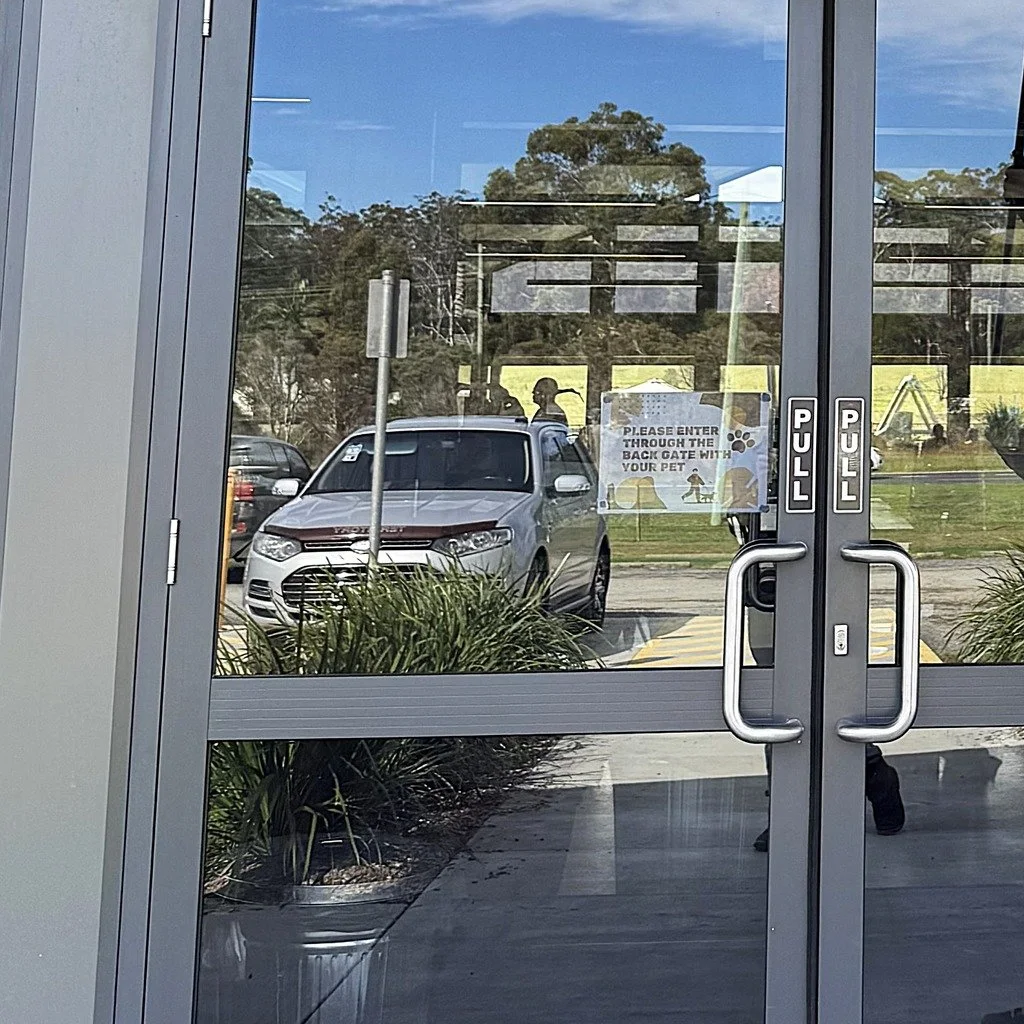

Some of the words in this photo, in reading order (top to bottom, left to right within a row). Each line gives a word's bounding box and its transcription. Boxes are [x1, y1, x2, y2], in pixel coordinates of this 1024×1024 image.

[622, 426, 674, 436] PLEASE
[676, 426, 719, 436] ENTER
[622, 438, 685, 448] THROUGH
[688, 438, 714, 448] THE
[622, 450, 658, 460] BACK
[661, 450, 696, 460] GATE
[699, 450, 732, 459] WITH
[792, 408, 812, 502] PULL
[840, 409, 860, 502] PULL
[621, 462, 657, 472] YOUR
[660, 462, 686, 472] PET
